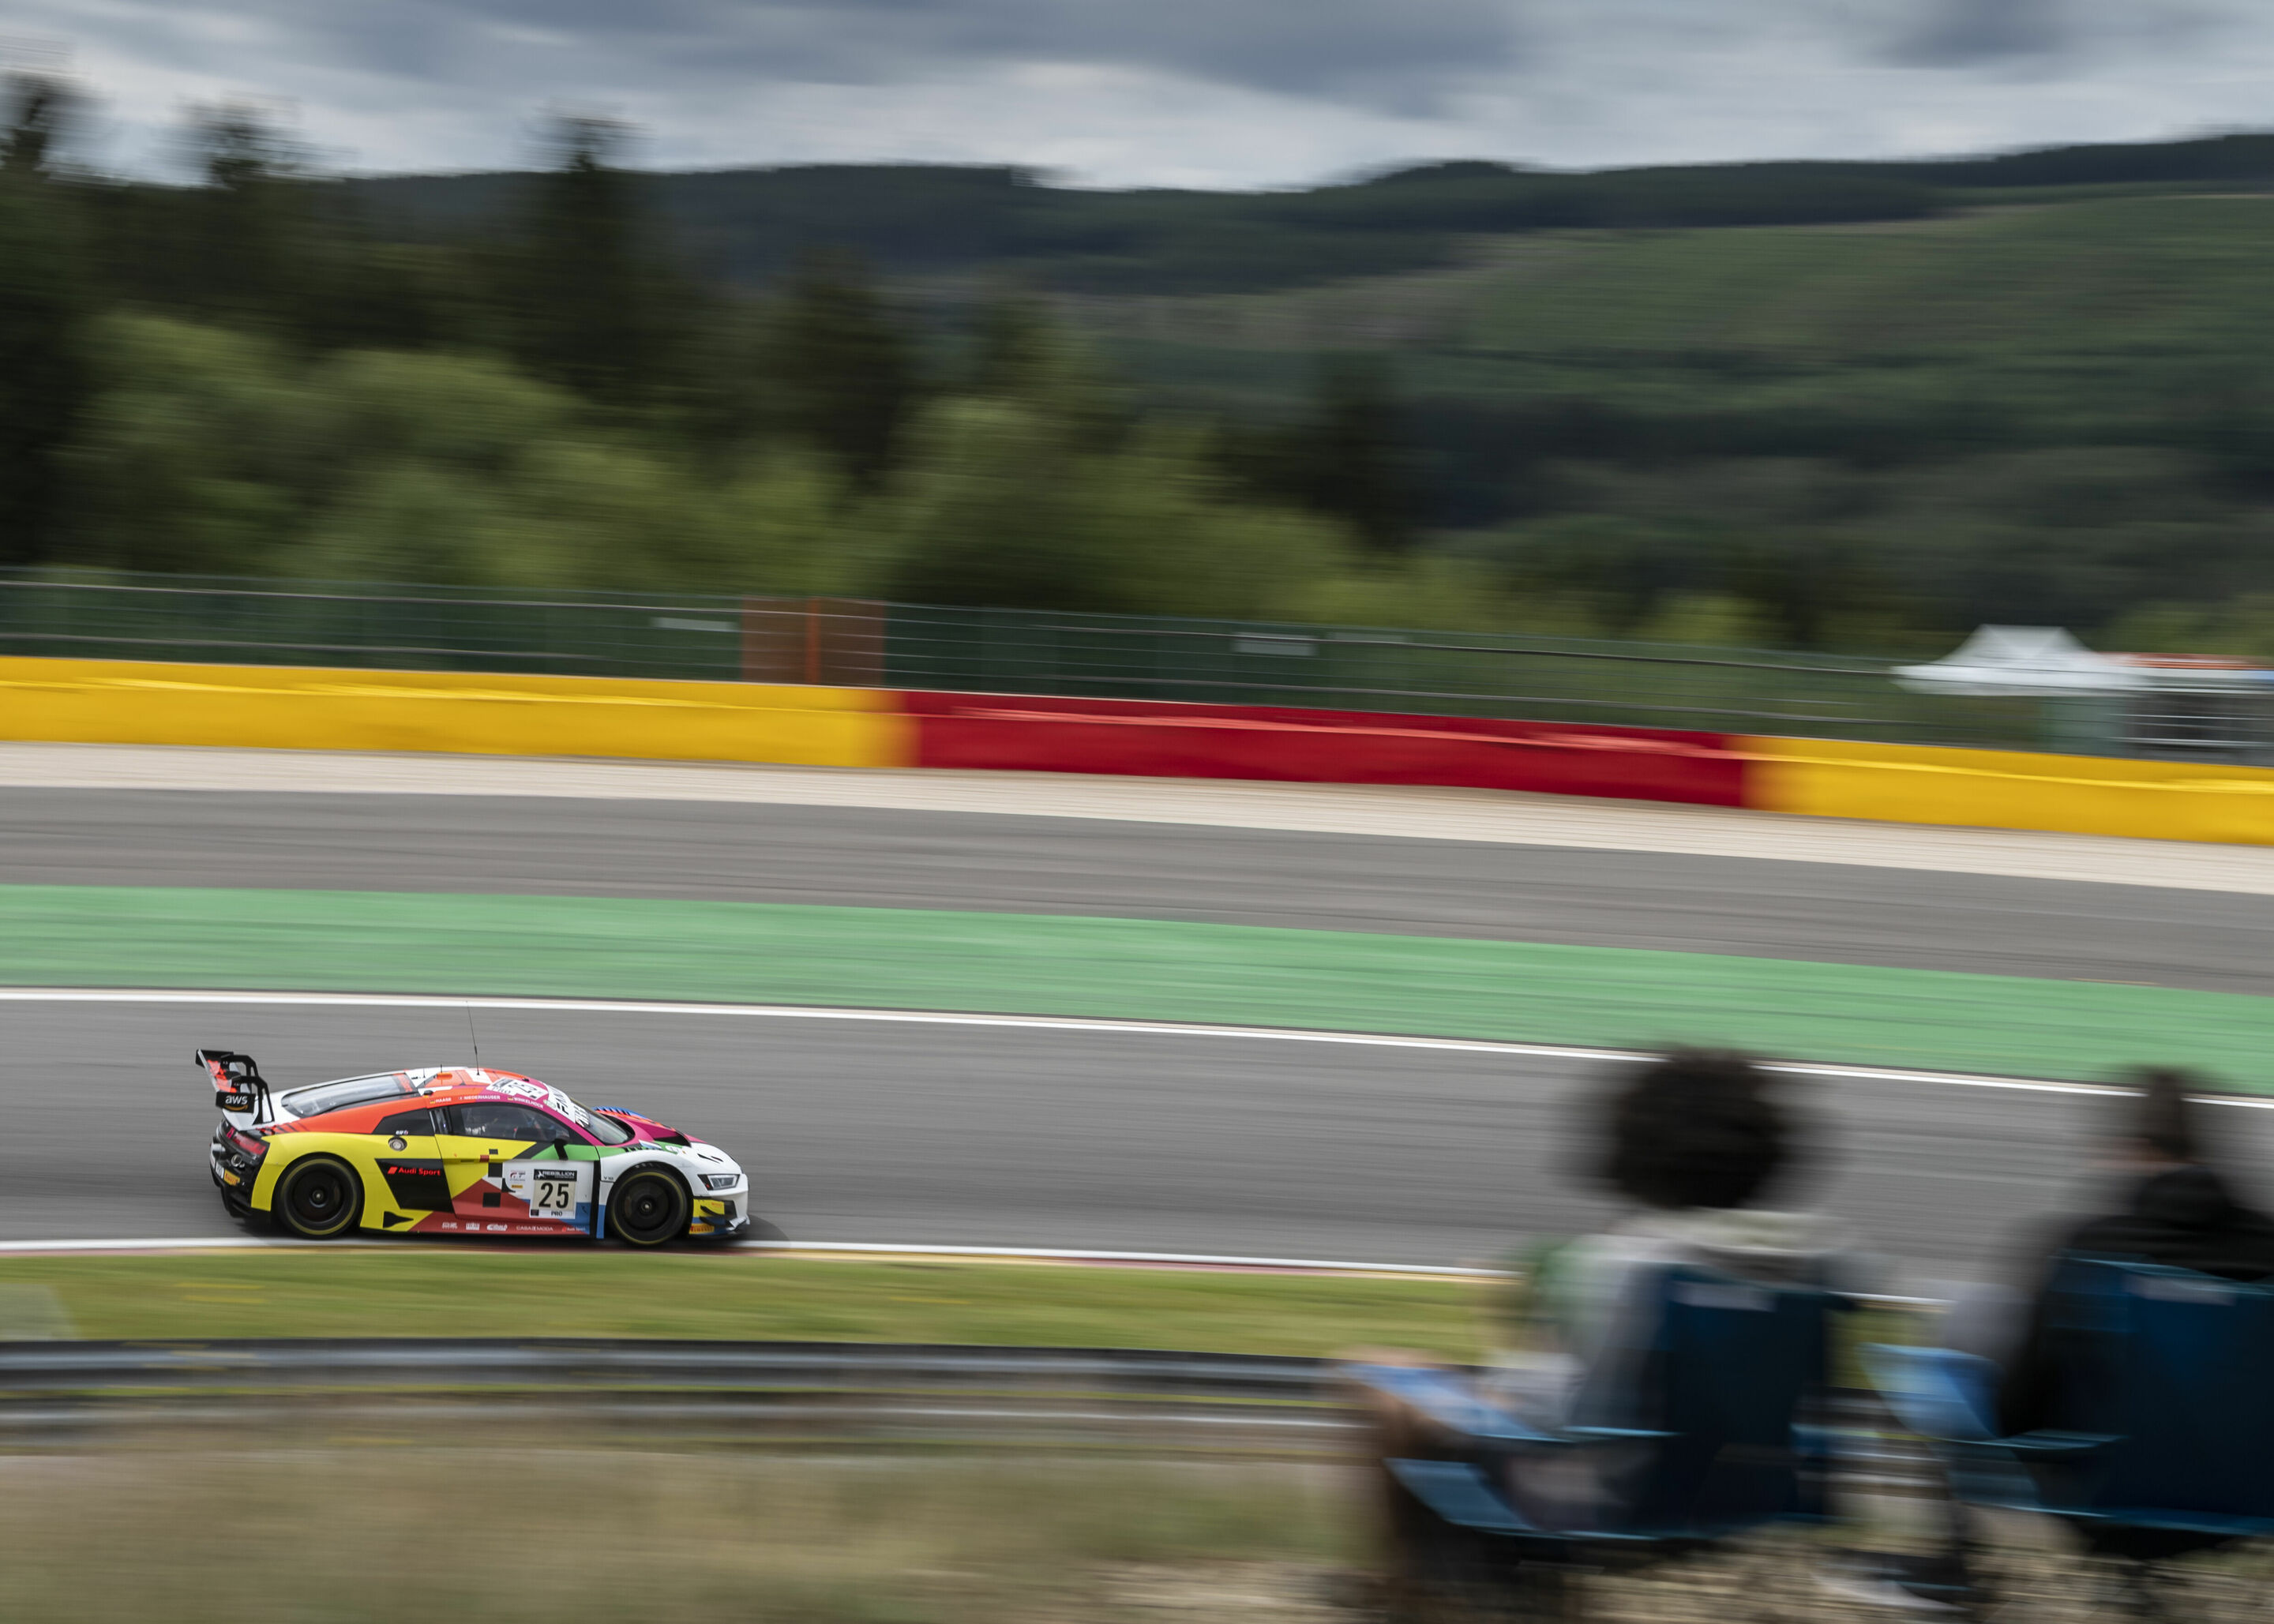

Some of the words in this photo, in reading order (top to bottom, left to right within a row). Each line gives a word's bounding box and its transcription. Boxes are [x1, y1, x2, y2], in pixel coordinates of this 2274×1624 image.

[225, 1095, 248, 1105] aws
[513, 1097, 544, 1109] WINKELHOCK
[538, 1182, 569, 1209] 25
